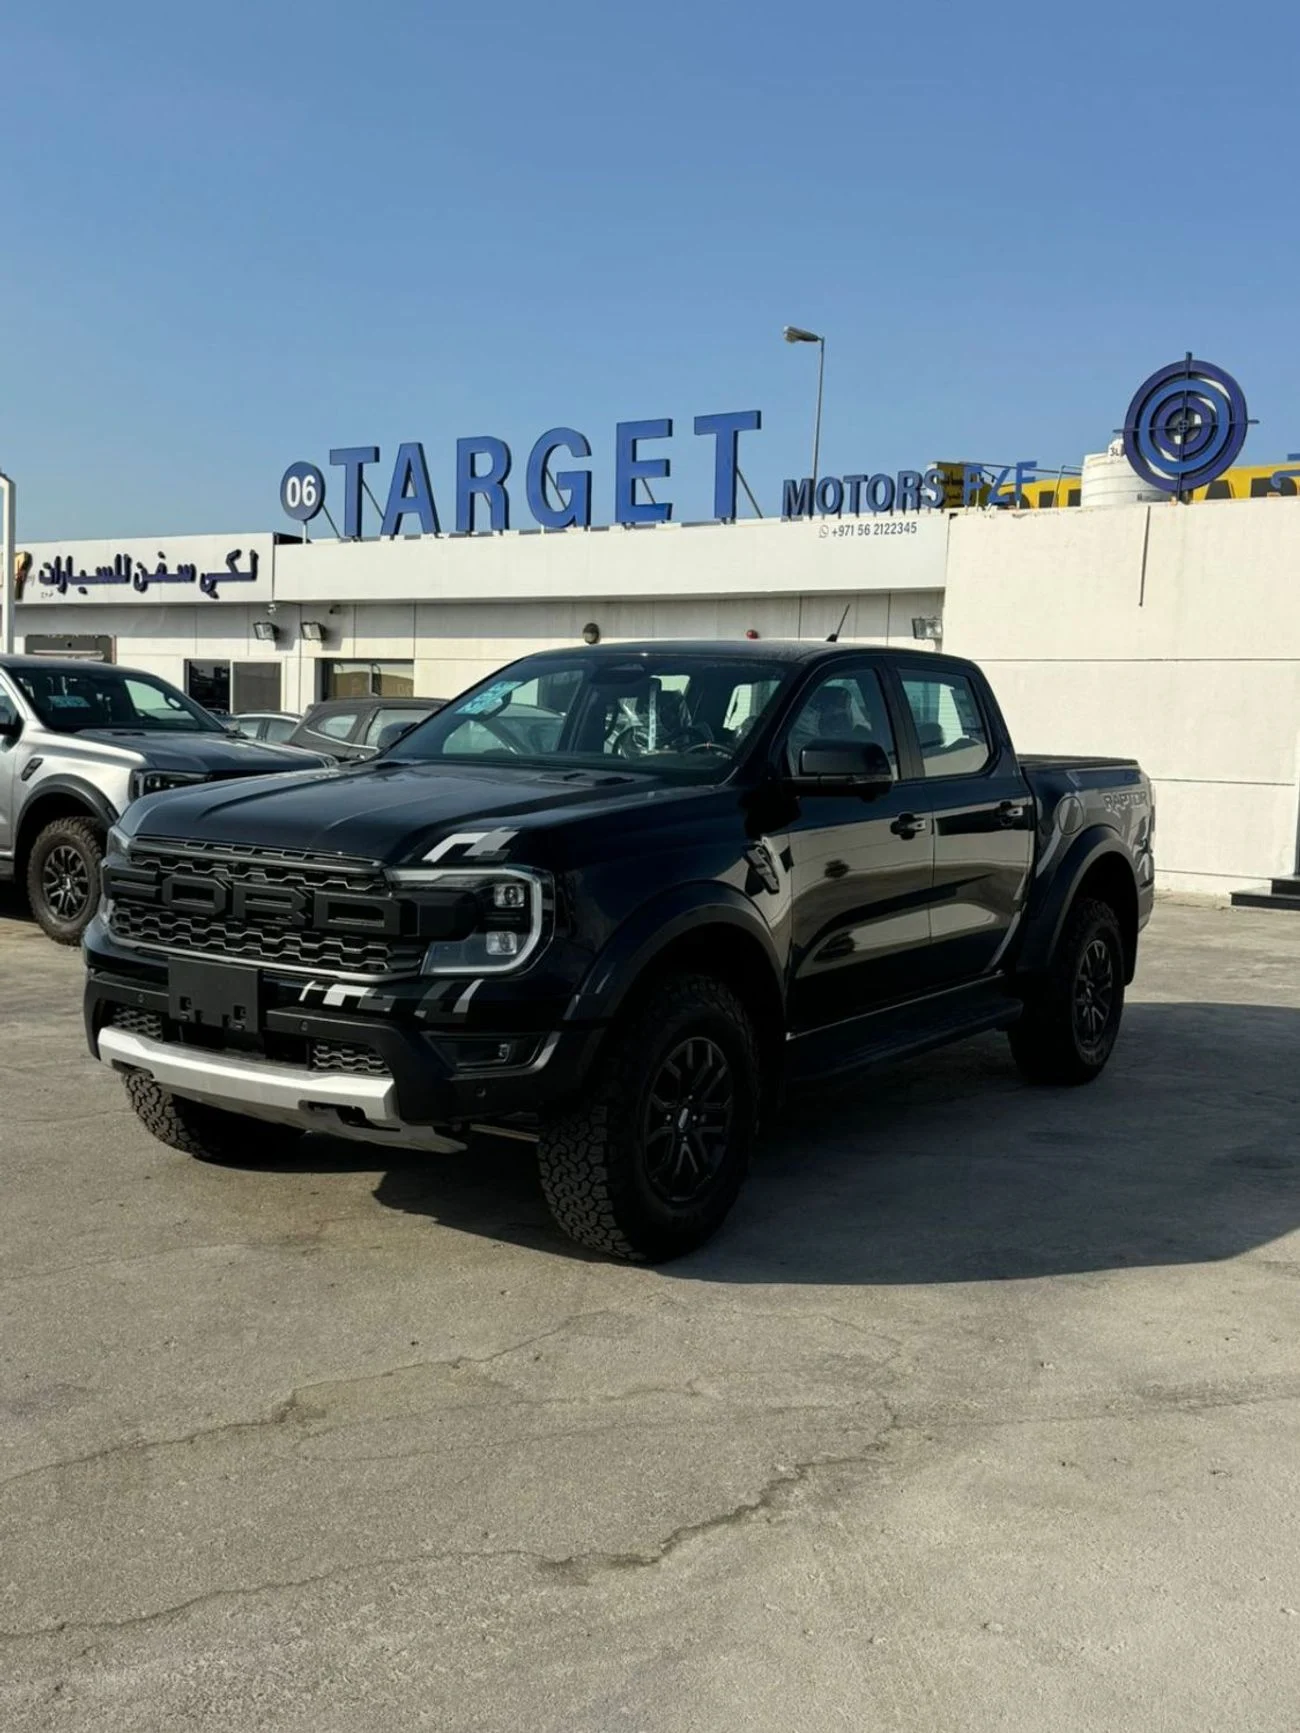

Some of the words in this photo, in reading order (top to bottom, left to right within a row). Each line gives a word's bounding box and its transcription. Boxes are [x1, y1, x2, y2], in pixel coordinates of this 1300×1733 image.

[286, 475, 317, 508] 06
[329, 410, 762, 540] TARGET
[781, 468, 946, 518] MOTORS
[832, 525, 854, 537] +971
[857, 524, 871, 536] 56
[873, 521, 918, 536] 2122345
[103, 864, 402, 937] FORD
